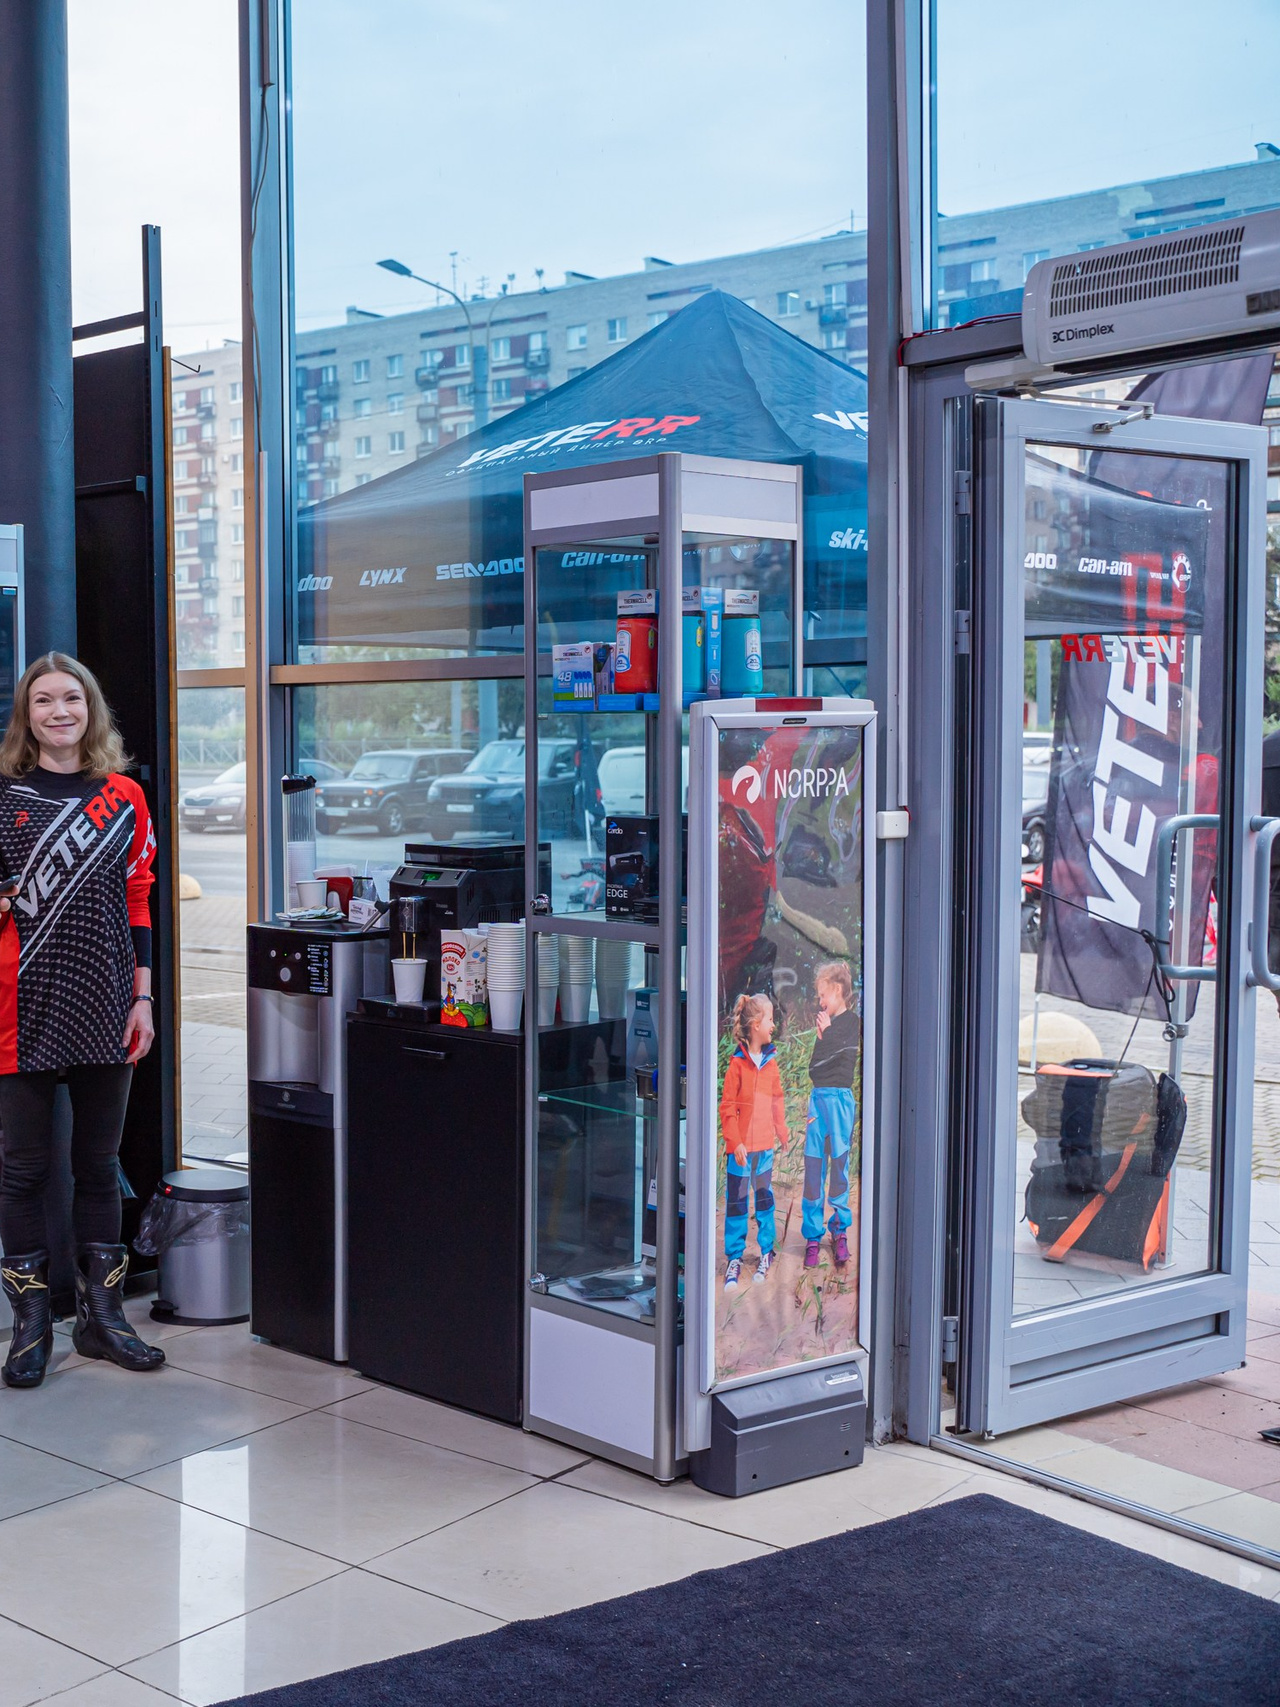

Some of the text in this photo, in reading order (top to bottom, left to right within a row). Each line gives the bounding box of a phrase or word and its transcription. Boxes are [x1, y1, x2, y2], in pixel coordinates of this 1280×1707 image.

[1066, 324, 1114, 341] Dimplex
[457, 415, 701, 468] VETERR
[568, 440, 625, 453] ДИЛЕР
[828, 528, 868, 551] ski-
[297, 574, 334, 592] doo
[358, 567, 408, 587] LYNX
[561, 551, 645, 568] can-a
[1078, 557, 1133, 576] can-am
[557, 671, 572, 682] 48
[774, 767, 850, 799] NORPPA
[15, 782, 129, 919] VETERR
[607, 888, 628, 898] EDGE
